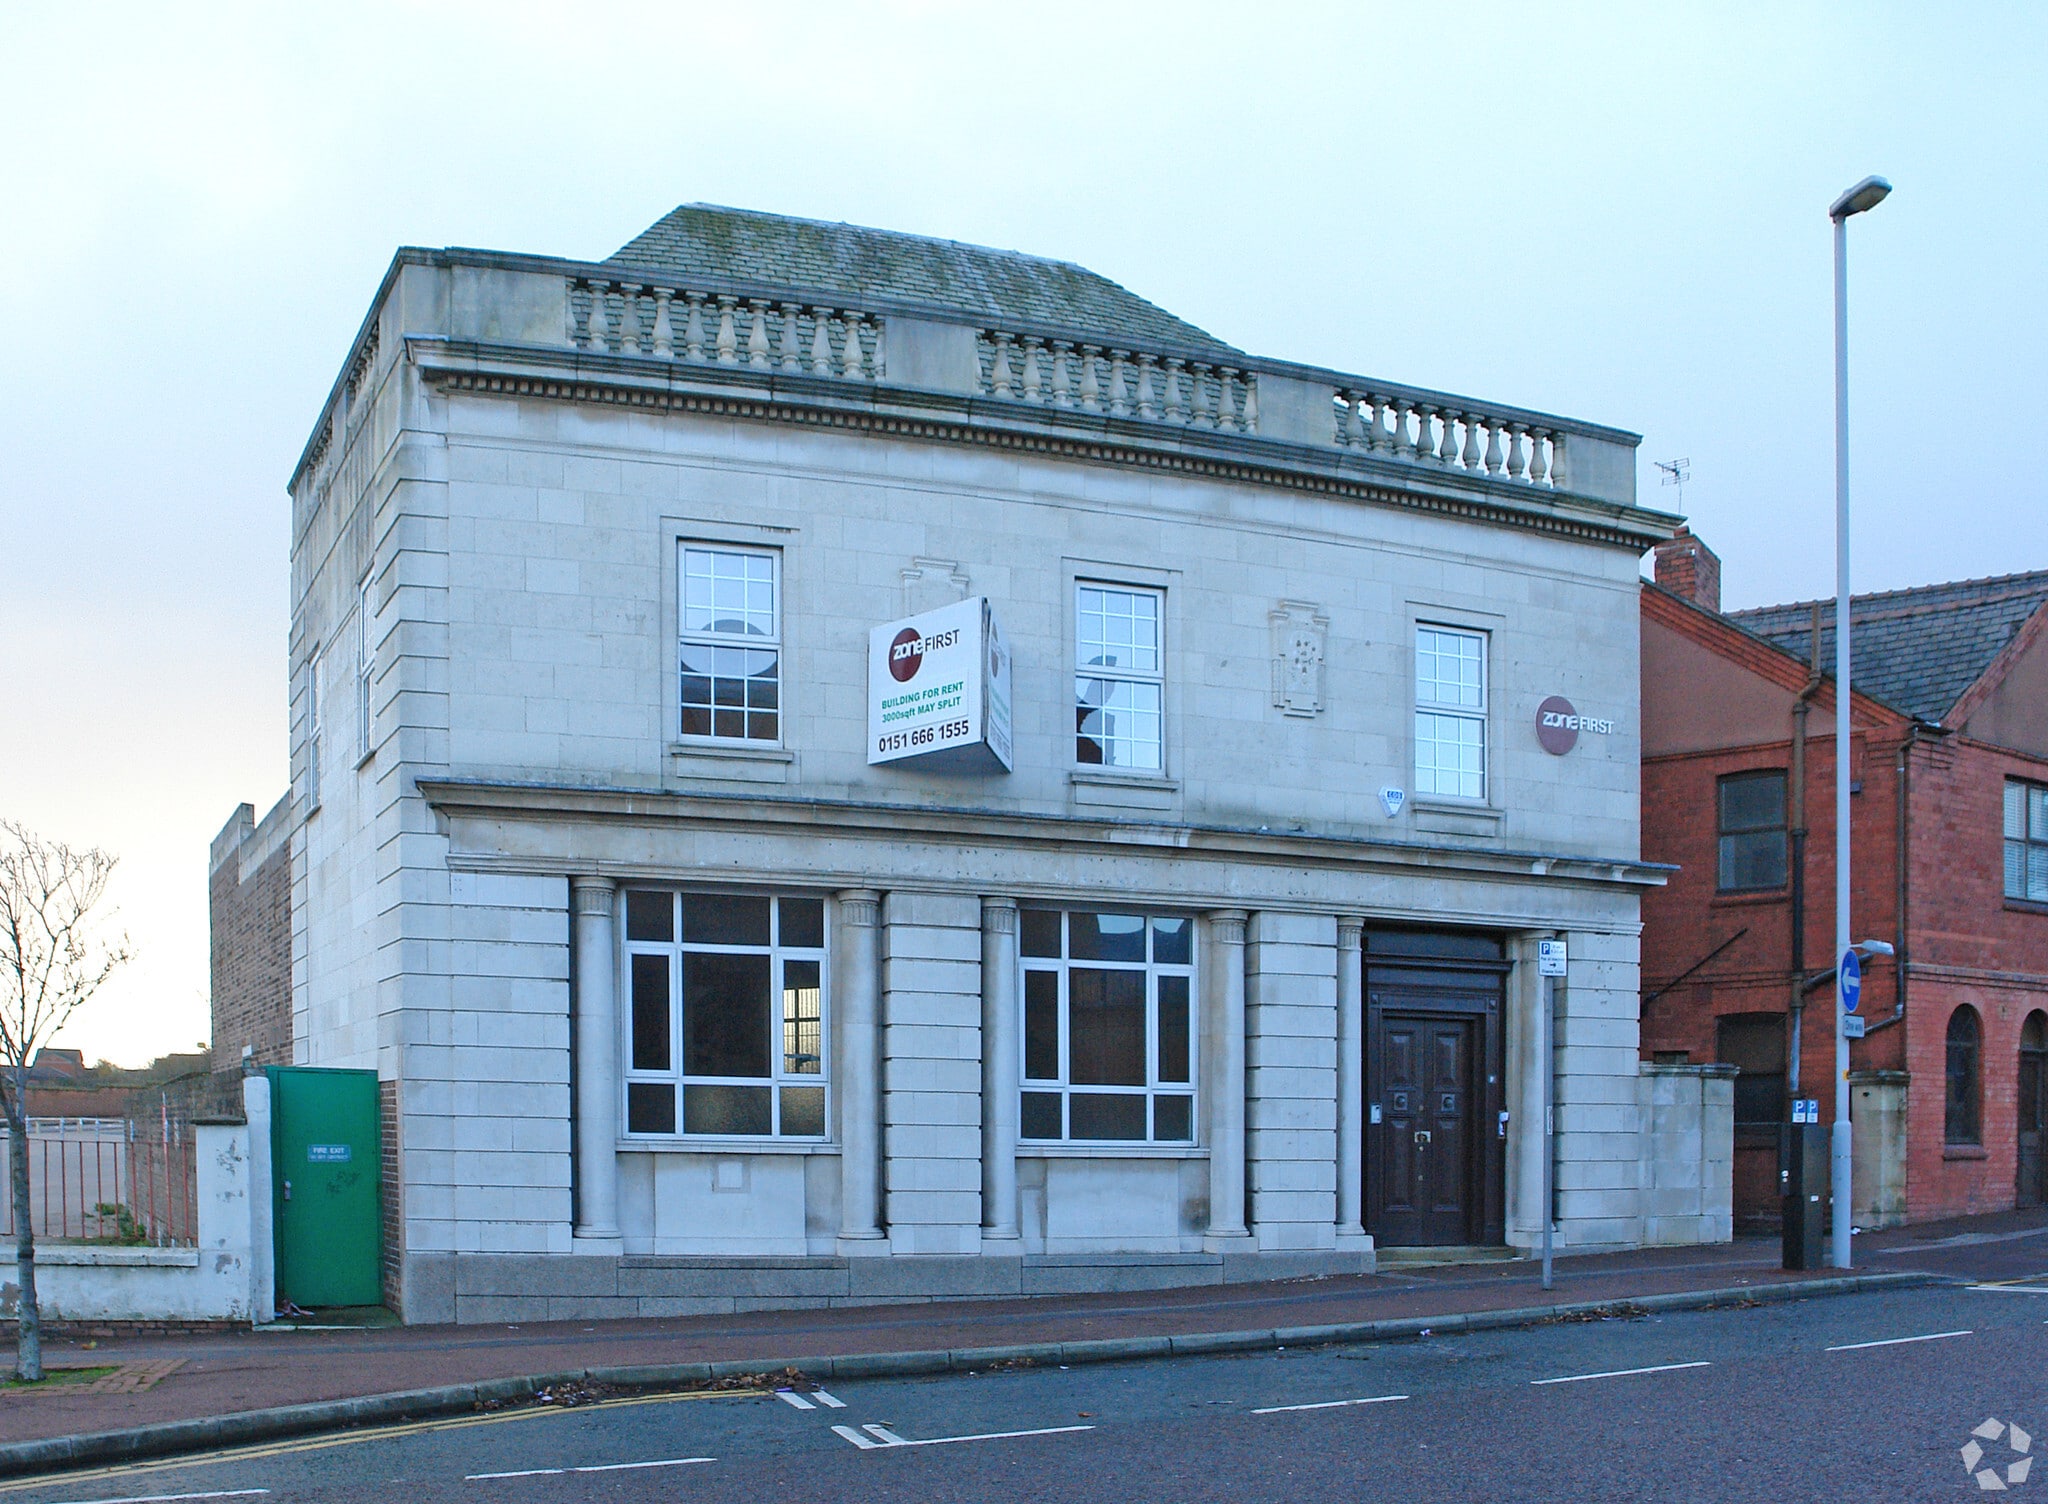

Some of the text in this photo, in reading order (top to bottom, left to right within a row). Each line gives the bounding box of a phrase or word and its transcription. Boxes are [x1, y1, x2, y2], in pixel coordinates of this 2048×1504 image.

[893, 629, 960, 660] zone FIRST
[881, 681, 964, 709] BUILDING FOR RENT
[882, 696, 962, 723] 3000sqft MAY SPLIT
[1542, 711, 1615, 735] zone FIRST
[879, 733, 908, 753] 0151
[911, 727, 934, 746] 666
[938, 720, 969, 740] 1555
[1796, 1101, 1804, 1112] P
[1810, 1101, 1817, 1112] P
